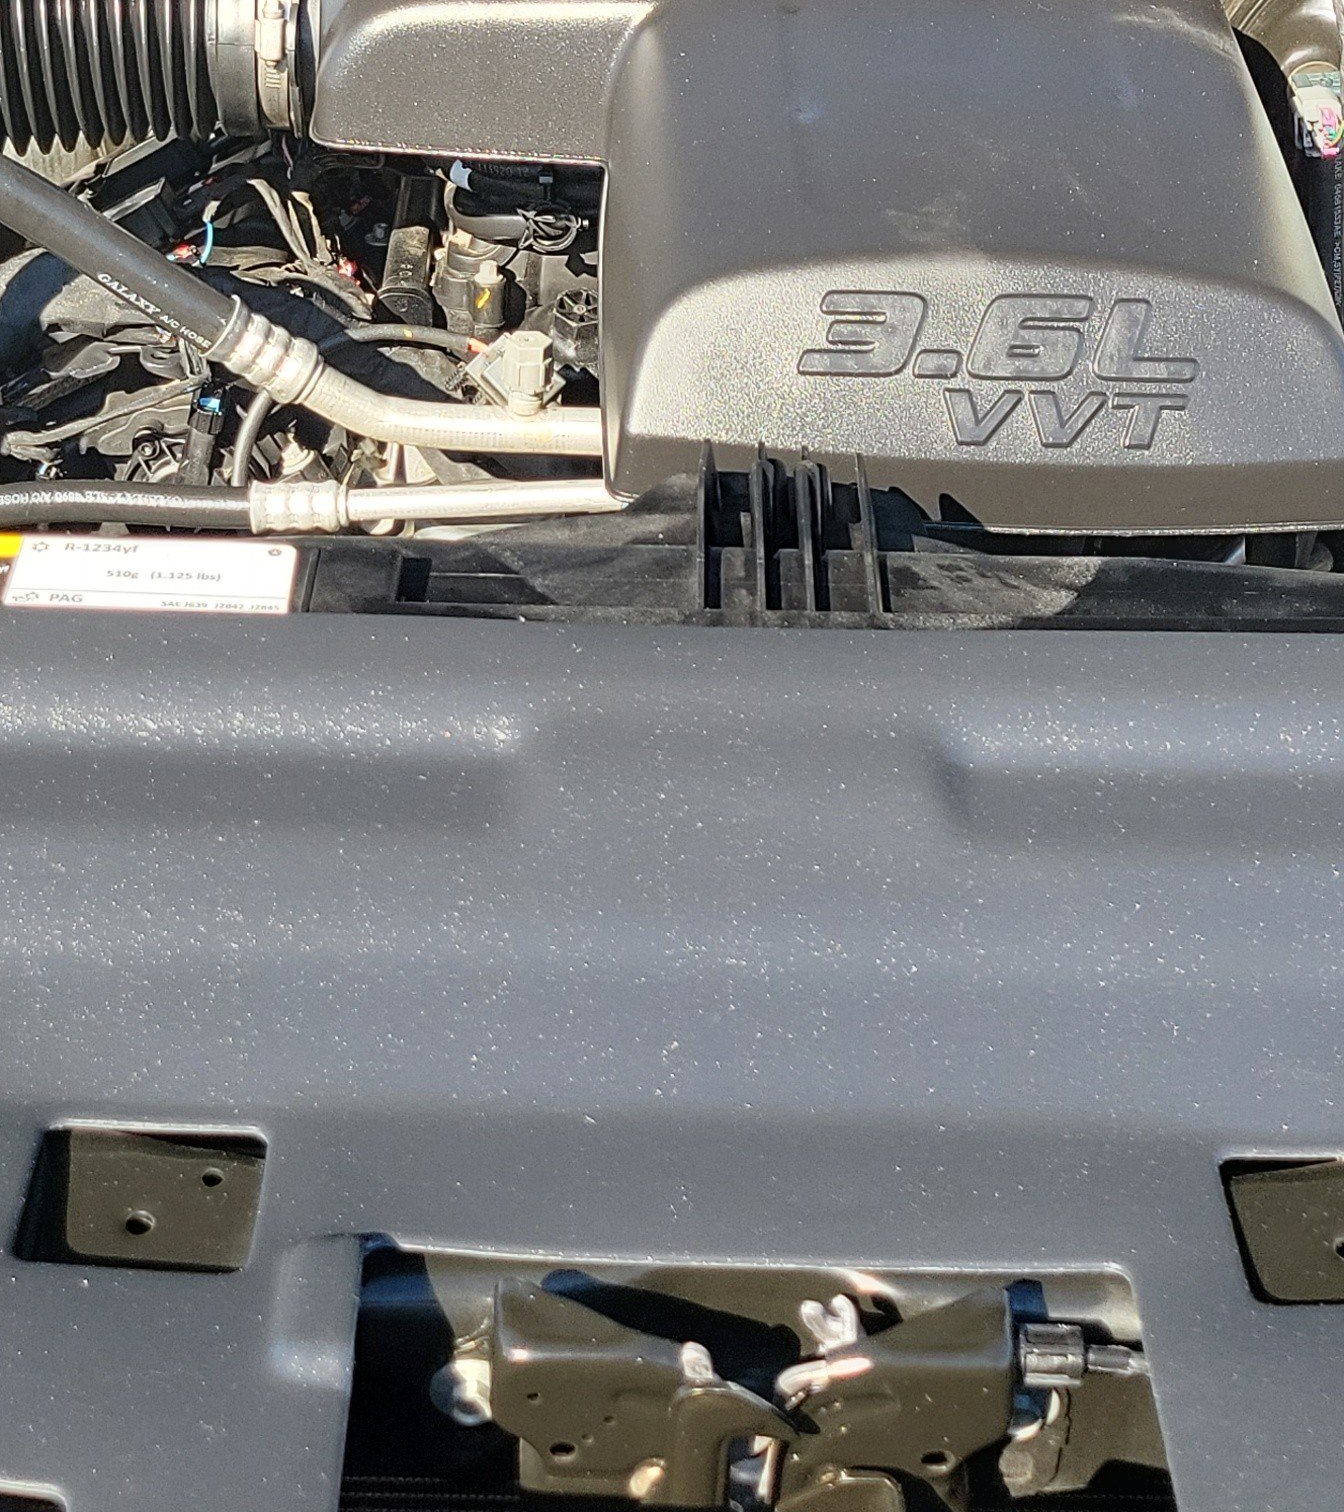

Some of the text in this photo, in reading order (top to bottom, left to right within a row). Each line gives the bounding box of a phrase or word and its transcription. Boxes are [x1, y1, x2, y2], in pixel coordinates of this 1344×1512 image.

[97, 273, 216, 350] GALAXY A/C HOSE
[797, 289, 1199, 383] 3.6L
[943, 387, 1190, 450] VVT
[64, 542, 140, 555] R-1234yf
[106, 569, 222, 582] 510g (1.125 lbs)
[49, 592, 84, 604] PAG
